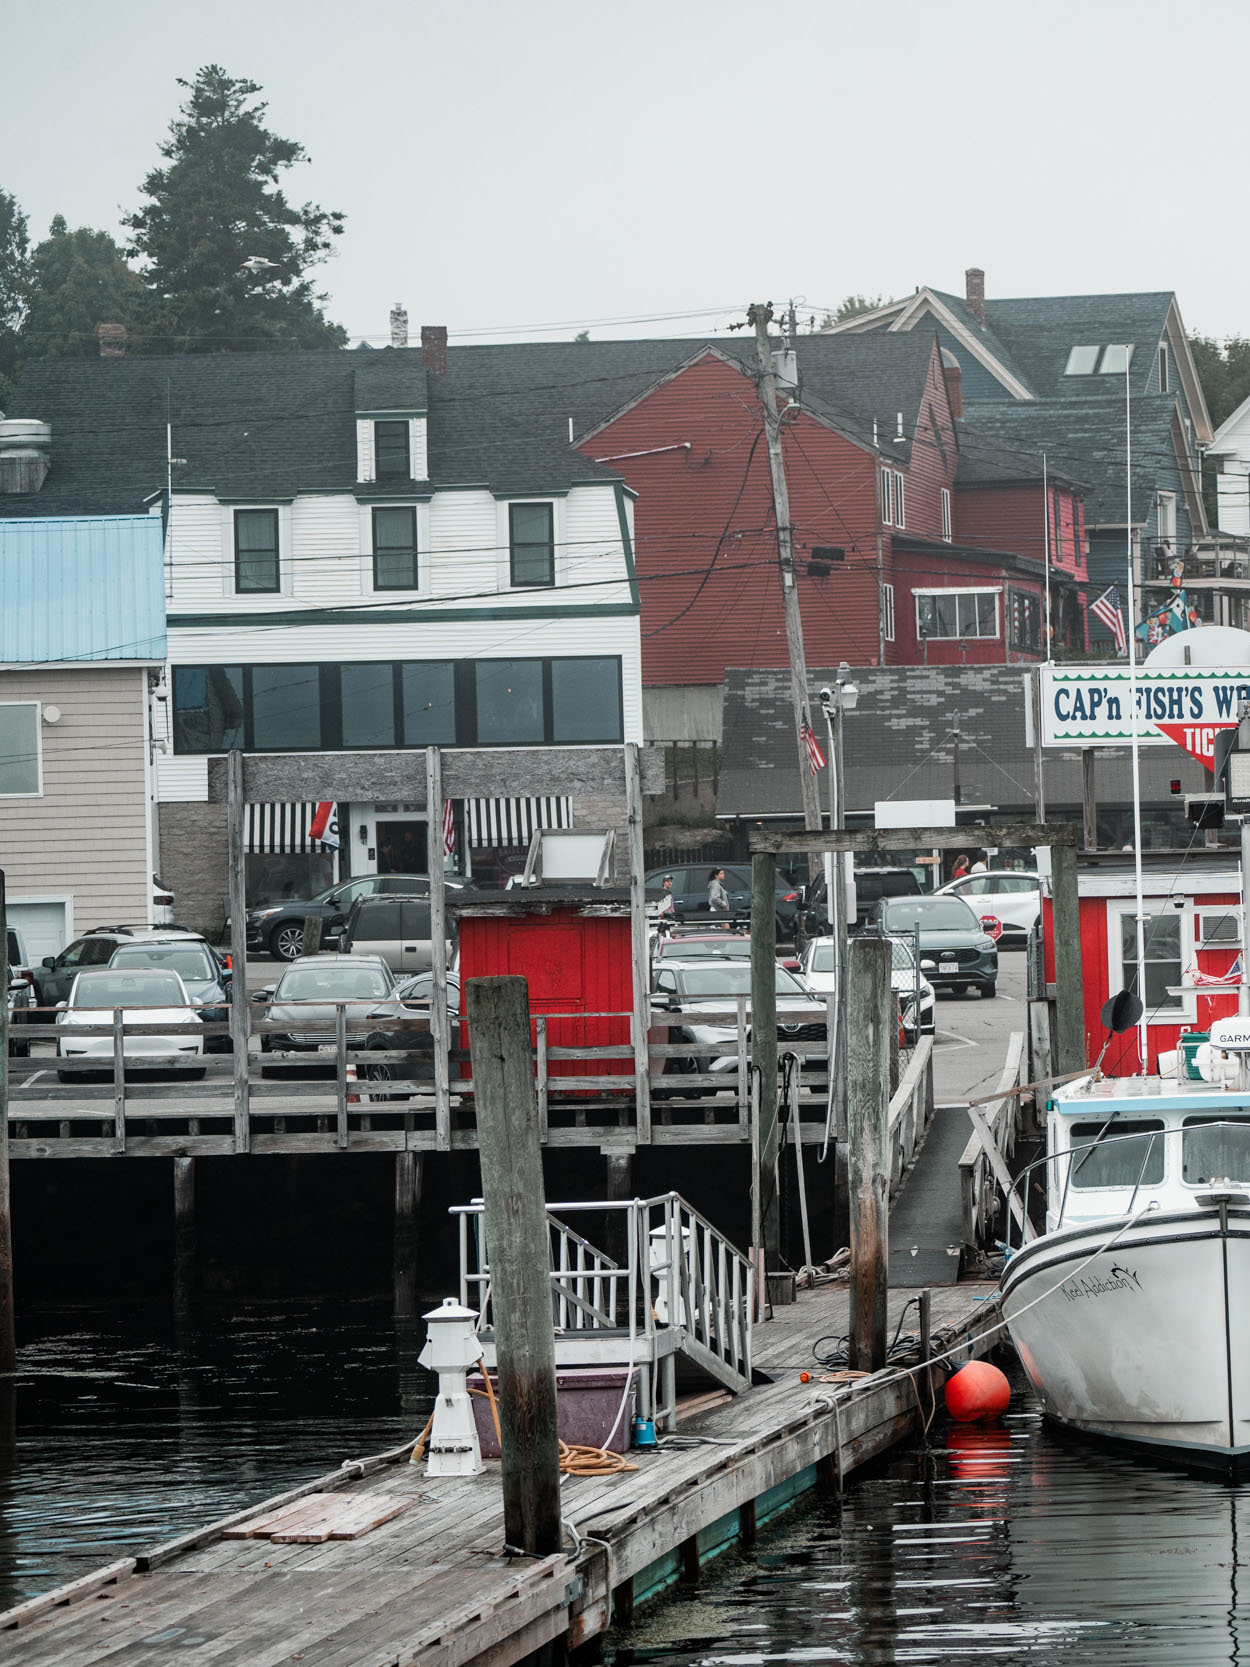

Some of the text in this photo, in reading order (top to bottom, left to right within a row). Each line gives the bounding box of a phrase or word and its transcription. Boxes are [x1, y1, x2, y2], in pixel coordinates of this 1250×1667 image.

[1054, 687, 1122, 721] CAP'n
[1129, 685, 1204, 720] FISH'S
[1080, 1275, 1136, 1299] Addiction
